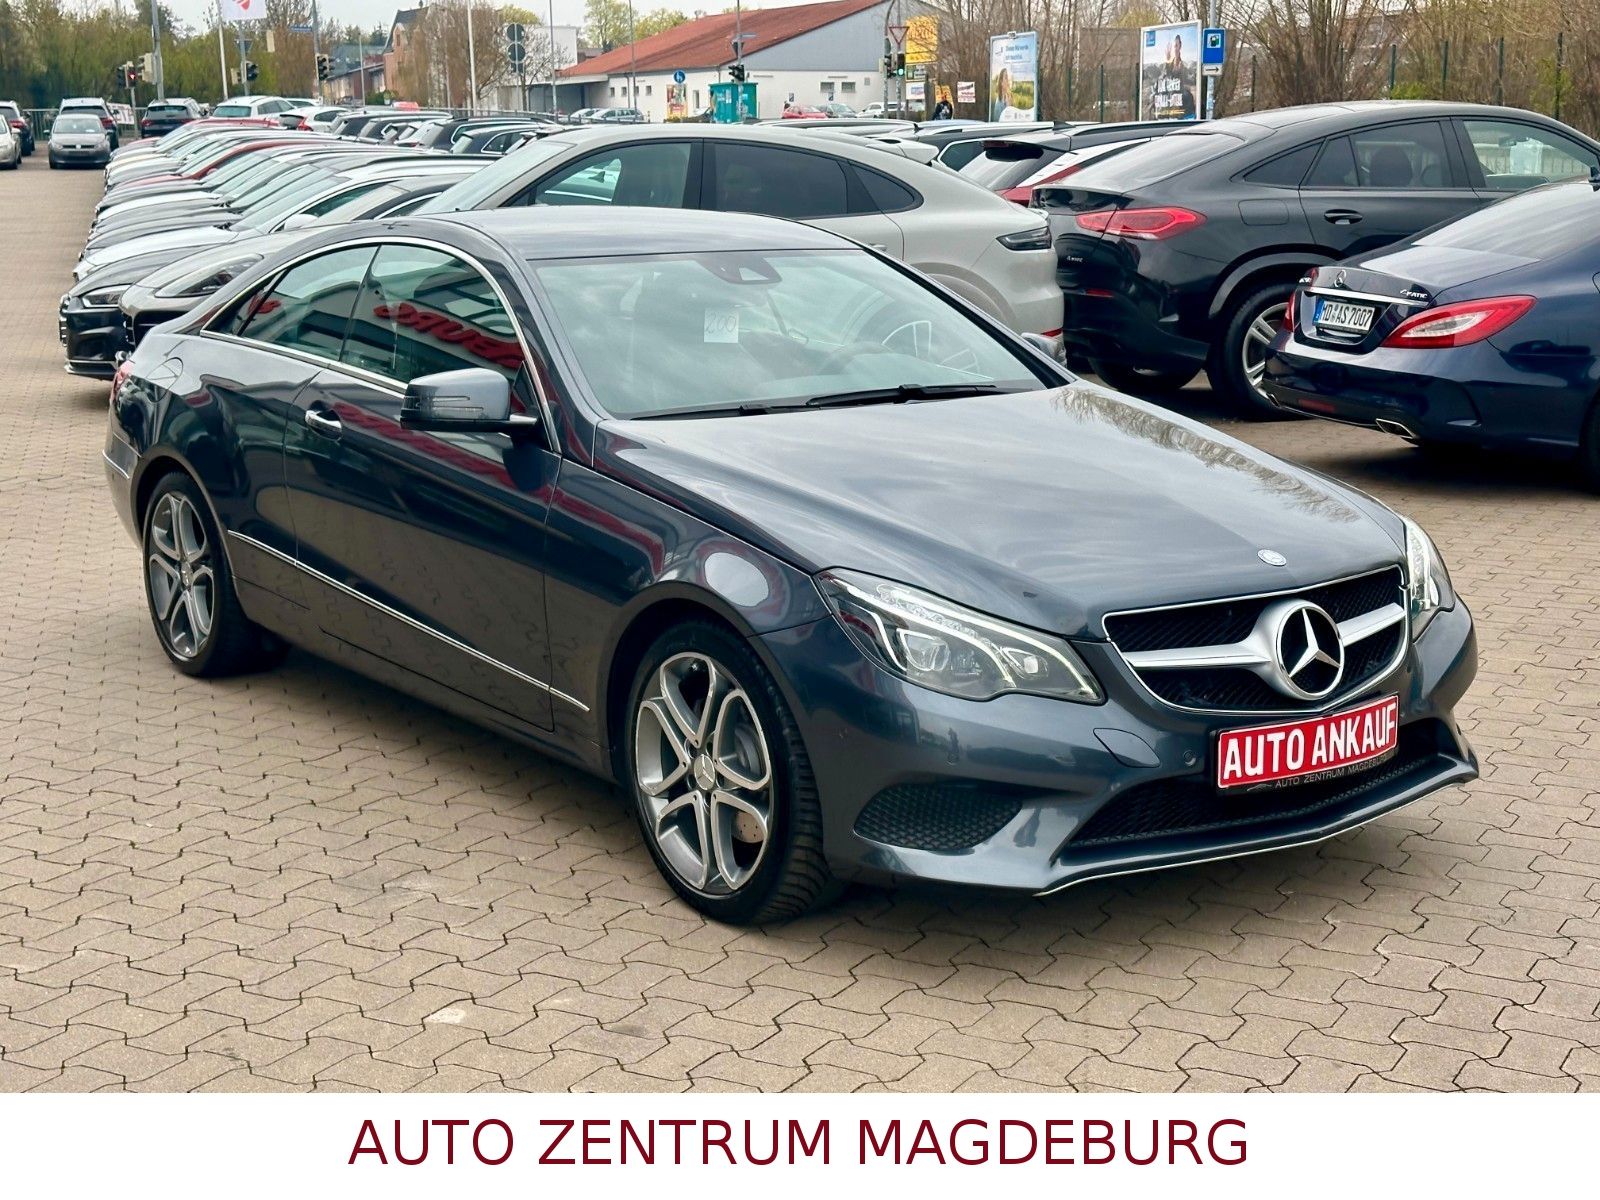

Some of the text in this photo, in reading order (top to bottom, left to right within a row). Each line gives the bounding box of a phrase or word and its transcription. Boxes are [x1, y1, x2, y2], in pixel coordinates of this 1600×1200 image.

[1335, 305, 1349, 324] AS
[1348, 308, 1374, 327] 7007
[1223, 703, 1396, 780] AUTO ANKAUF
[1275, 777, 1300, 788] AUTO
[1304, 768, 1345, 783] ZENTRUM
